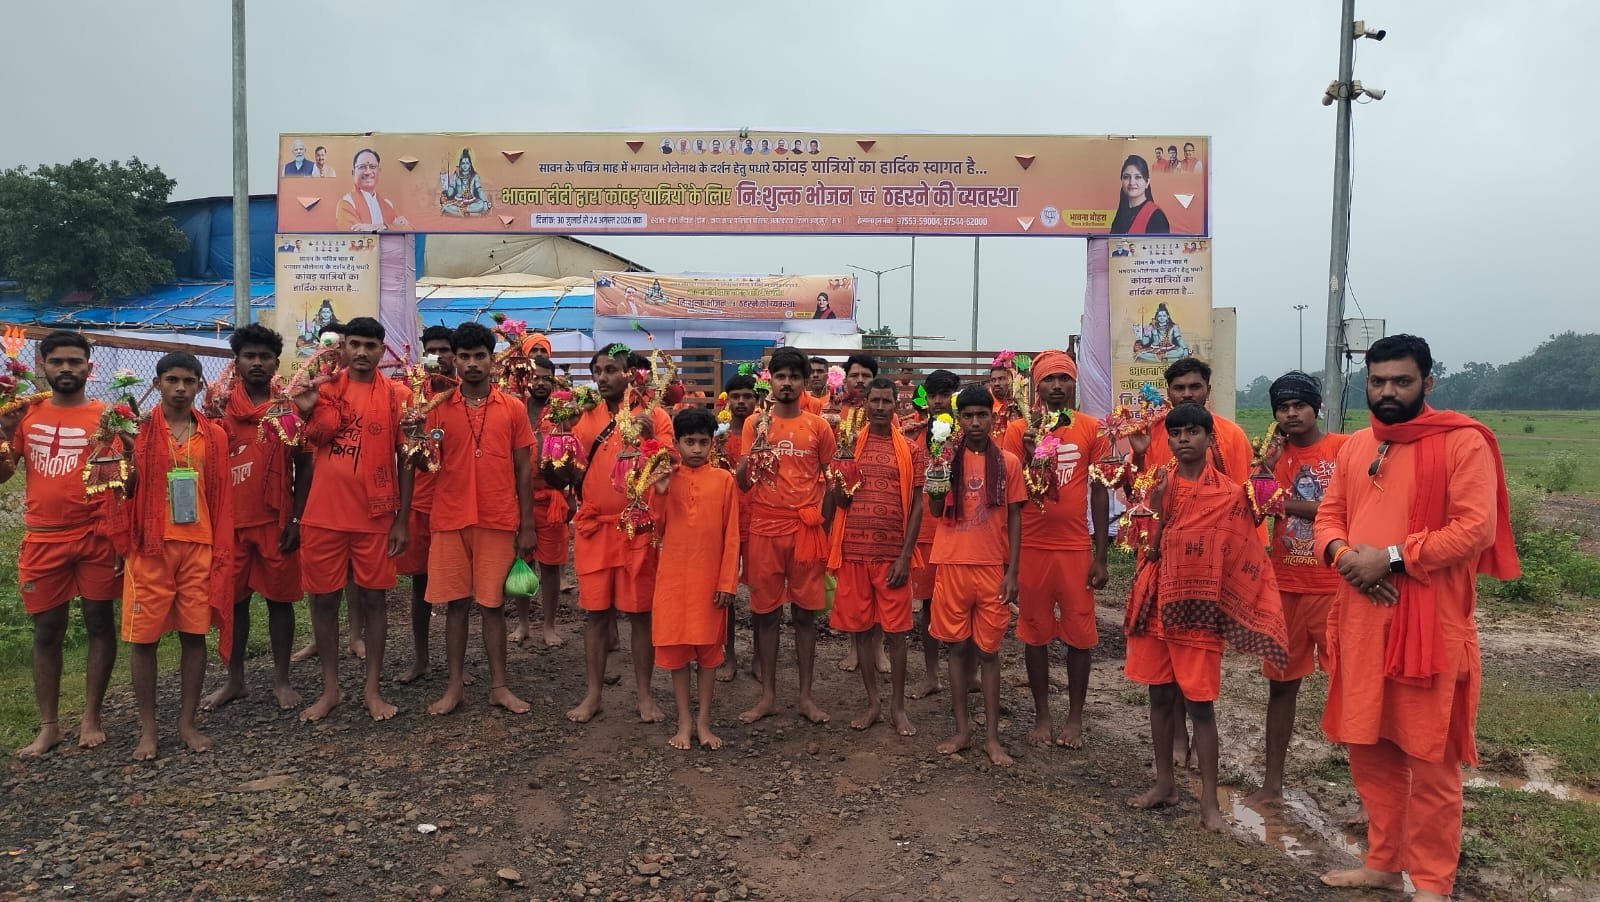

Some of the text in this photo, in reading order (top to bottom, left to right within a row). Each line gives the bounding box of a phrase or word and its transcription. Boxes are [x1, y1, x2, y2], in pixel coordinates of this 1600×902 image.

[539, 155, 987, 177] सावन के पवित्र माह में भगवान भोलेनाथ के दर्शन हेतु पधारे कांवड़ यात्रियों का हार्दिक स्वागत है...
[501, 187, 545, 205] भावना
[545, 183, 574, 205] दीदी
[574, 187, 603, 208] द्वारा
[604, 184, 640, 209] कांवड़
[641, 183, 689, 205] यात्रियों
[688, 183, 704, 205] के
[704, 183, 732, 205] लिए
[805, 181, 855, 206] भोजन
[860, 186, 876, 204] एवं
[883, 181, 930, 206] ठहरने
[932, 180, 955, 206] की
[957, 187, 1019, 206] व्यवस्था
[28, 443, 84, 478] महाकाल
